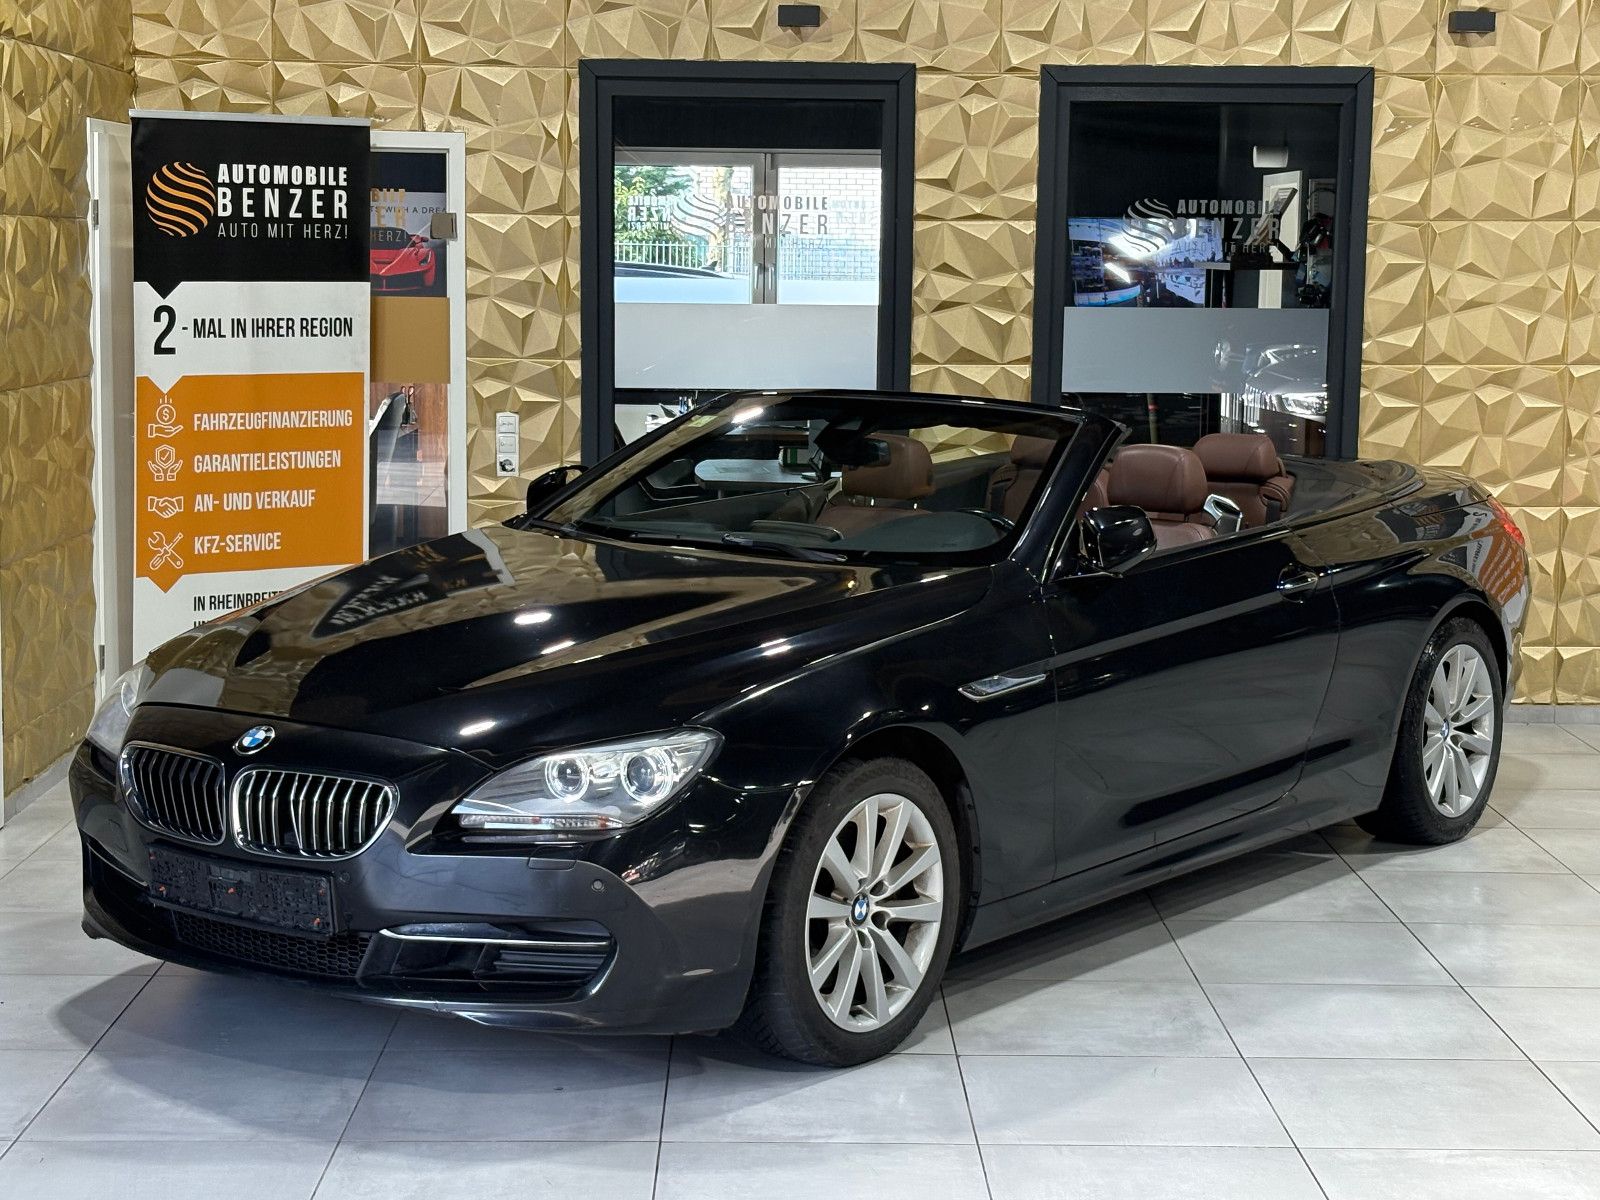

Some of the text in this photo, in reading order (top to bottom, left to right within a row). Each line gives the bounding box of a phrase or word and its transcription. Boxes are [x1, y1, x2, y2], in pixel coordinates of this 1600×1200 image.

[217, 163, 348, 186] AUTOMOBILE
[217, 186, 348, 219] BENZER
[1176, 199, 1281, 214] AUTOMOBILE
[217, 222, 348, 239] AUTO MIT HERZ!
[153, 304, 177, 356] 2
[193, 318, 227, 339] MAL
[230, 318, 247, 338] IN
[251, 317, 296, 338] IHRER
[299, 317, 353, 338] REGION
[193, 409, 353, 432] FAHRZEUGFINANZIERUNG
[193, 450, 342, 473] GARANTIELEISTUNGEN
[194, 489, 316, 513] AN- UND VERKAUF
[194, 532, 282, 555] KFZ-SERVICE
[193, 595, 206, 612] IN
